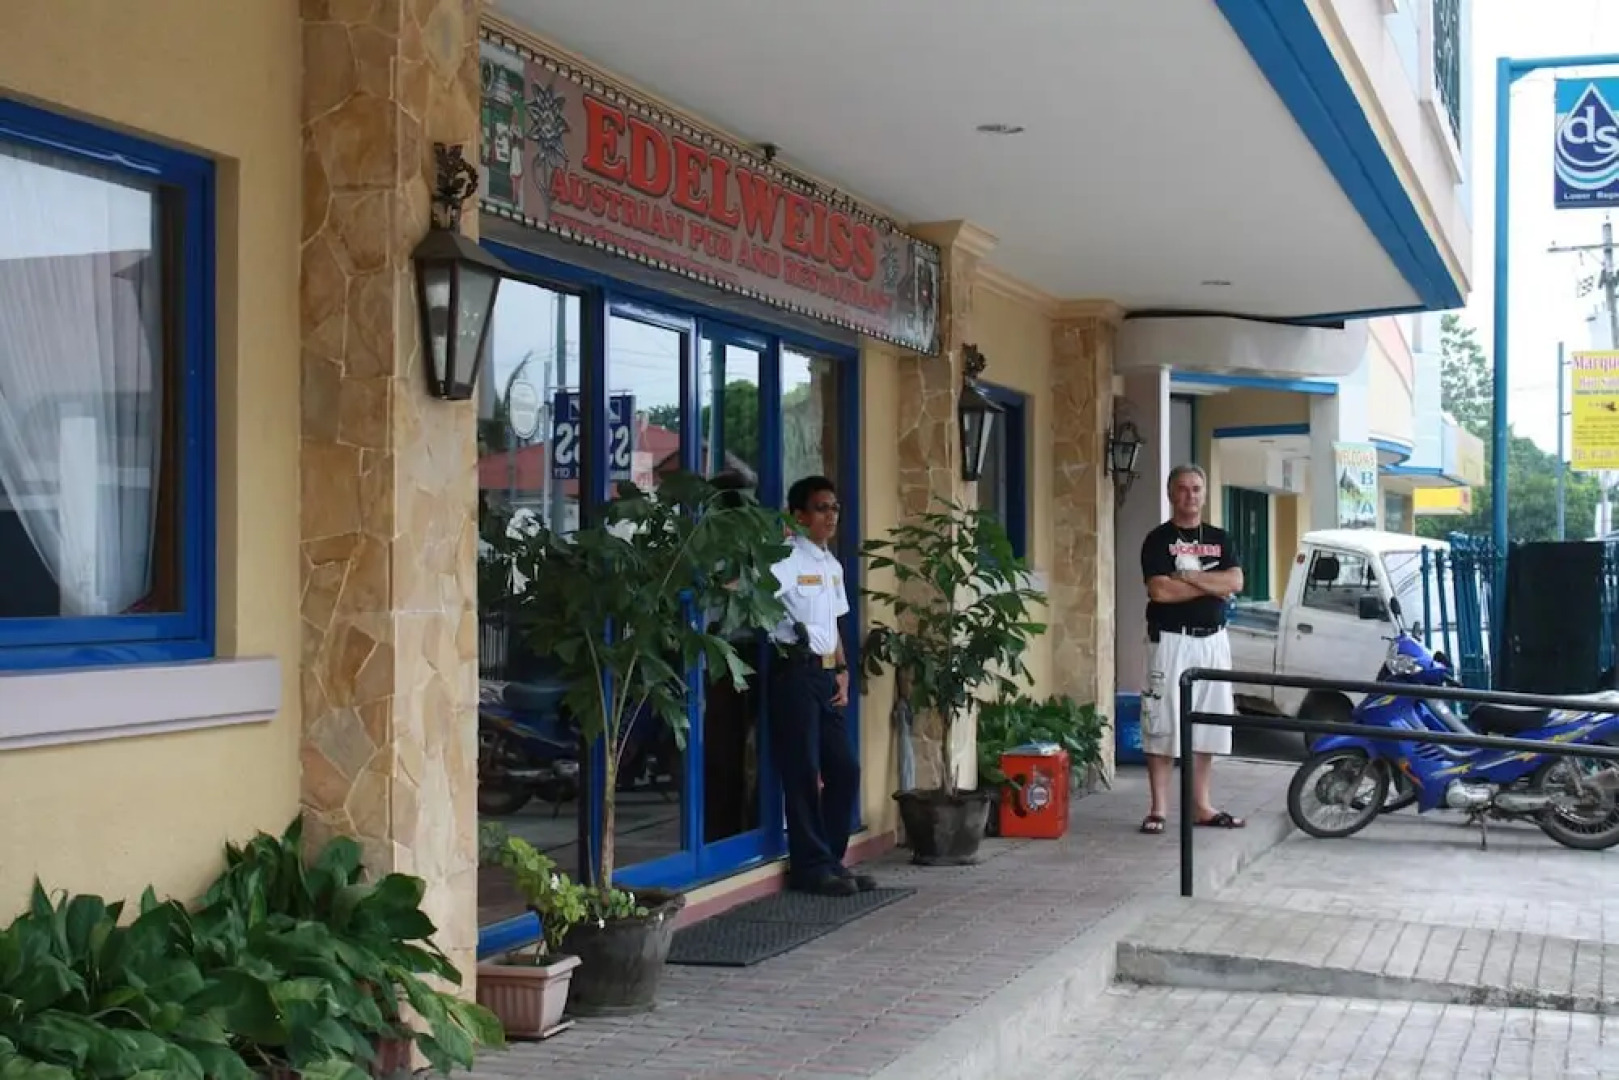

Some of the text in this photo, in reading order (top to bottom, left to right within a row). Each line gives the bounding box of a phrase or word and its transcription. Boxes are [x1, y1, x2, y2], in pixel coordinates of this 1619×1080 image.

[551, 167, 684, 246] AUSTRIAN
[688, 218, 733, 262] PUB
[737, 237, 781, 279] AND
[582, 94, 876, 282] EDELWEISS
